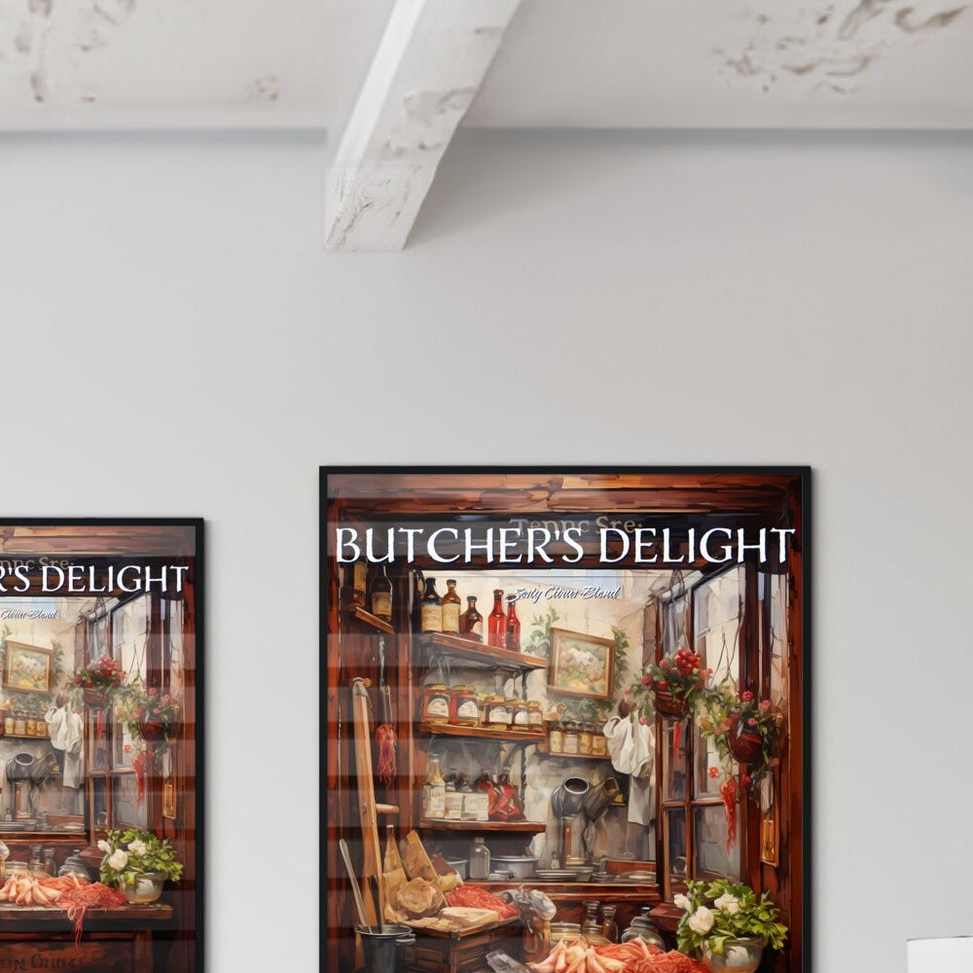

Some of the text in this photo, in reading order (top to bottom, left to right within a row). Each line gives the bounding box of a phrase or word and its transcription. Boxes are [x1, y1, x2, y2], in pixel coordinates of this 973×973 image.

[336, 527, 795, 563] BUTCHER'S DELIGHT
[42, 565, 189, 592] DELIGHT
